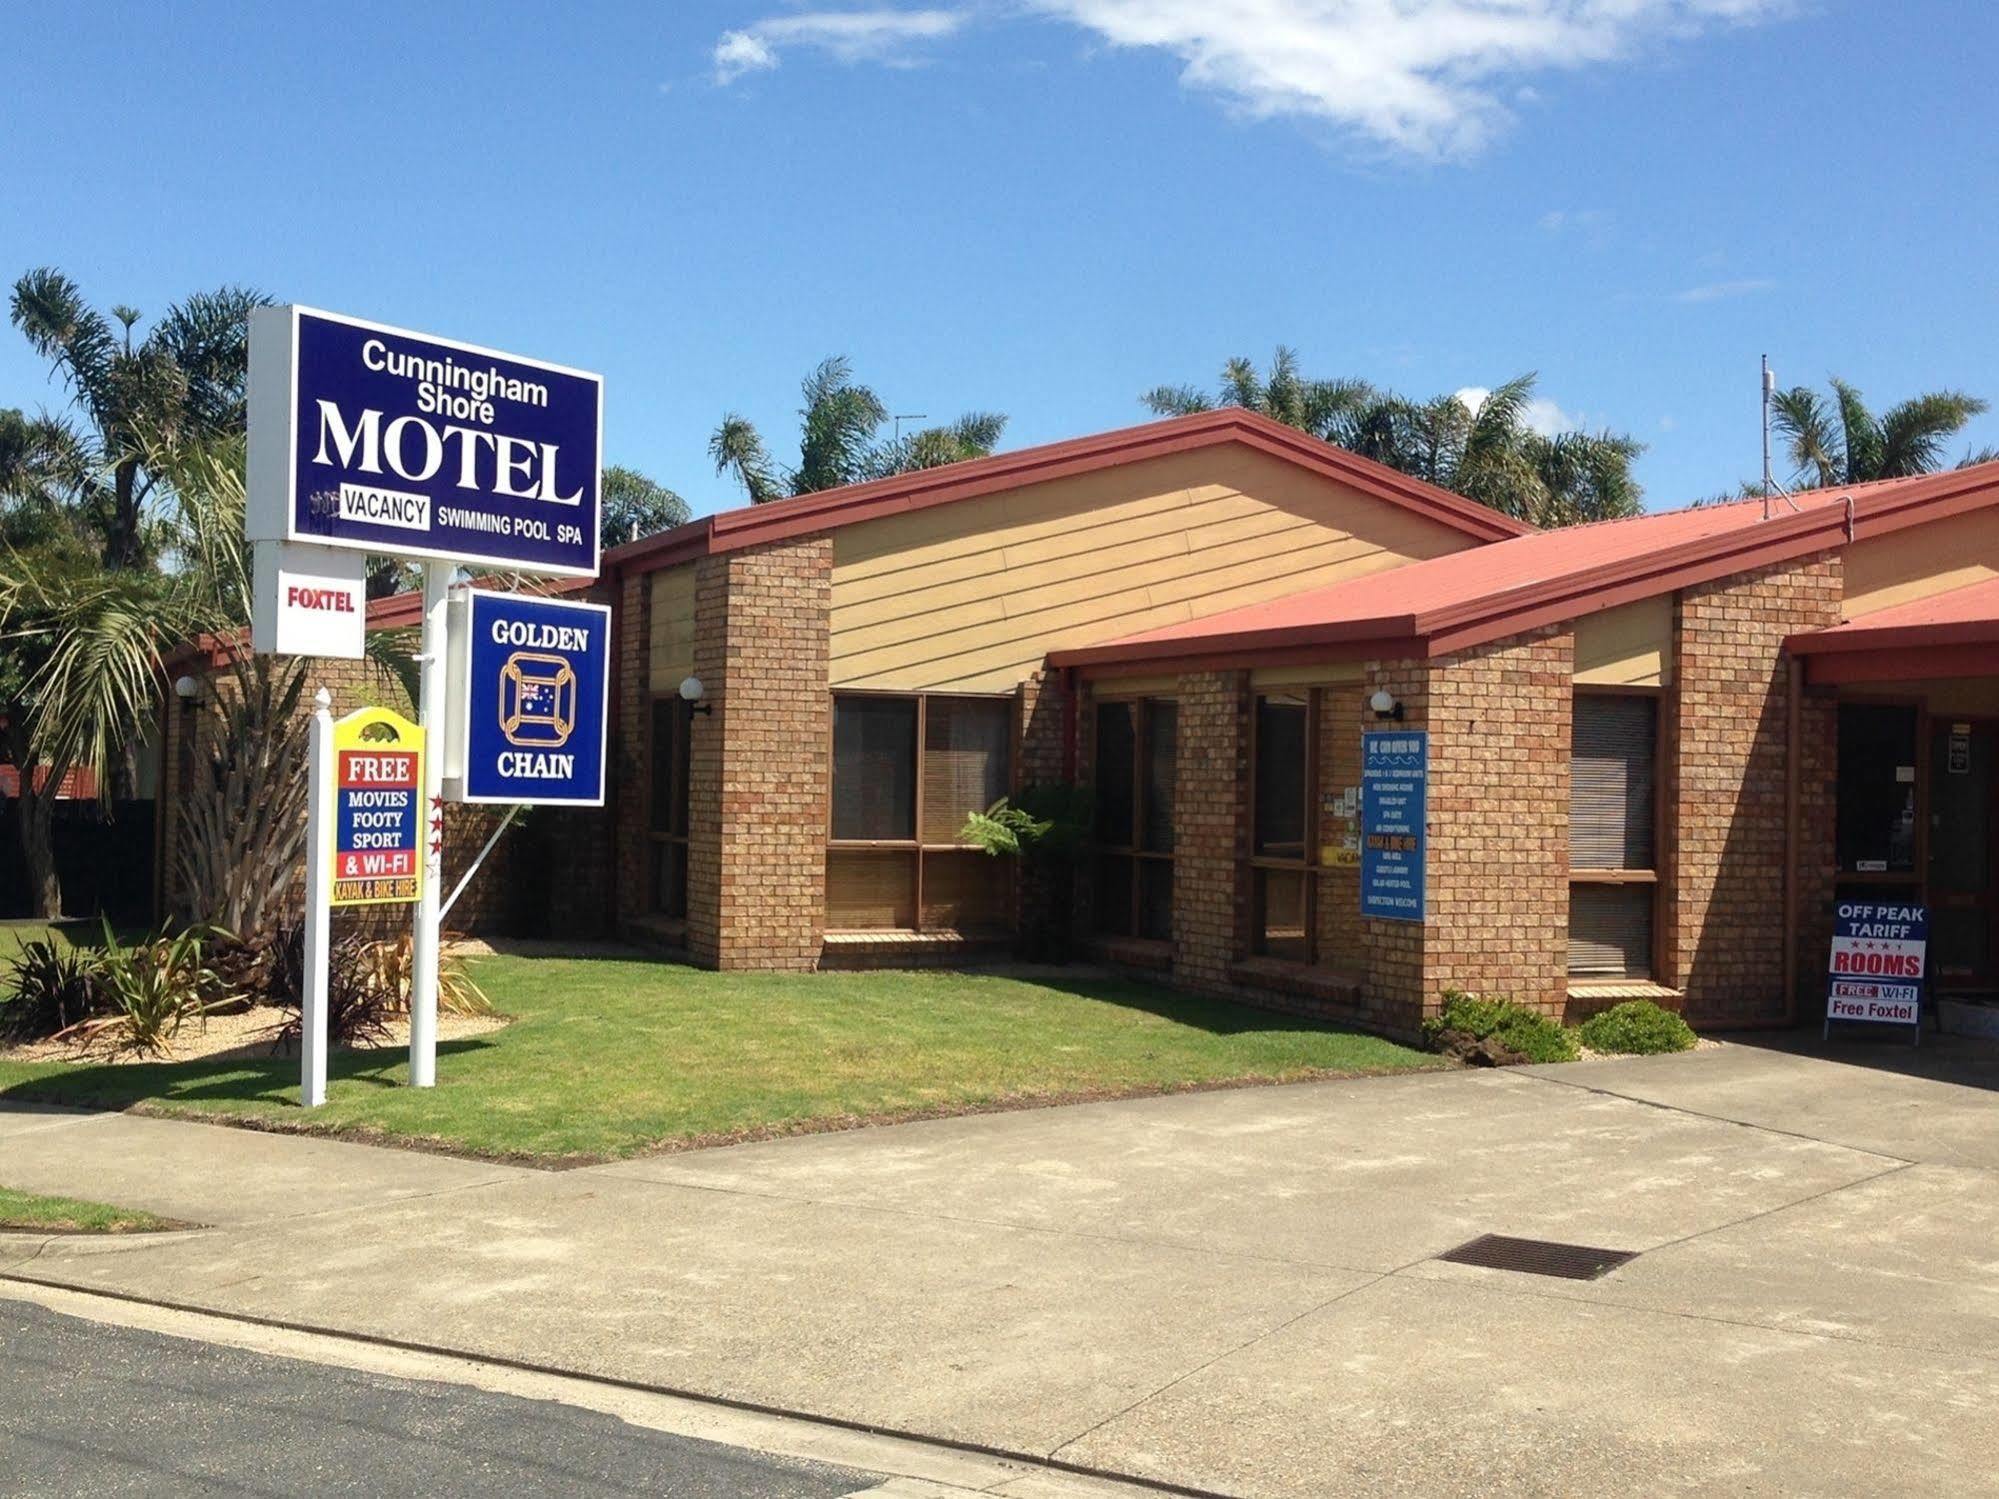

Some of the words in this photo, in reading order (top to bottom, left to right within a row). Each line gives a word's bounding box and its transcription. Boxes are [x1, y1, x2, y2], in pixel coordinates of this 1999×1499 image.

[363, 339, 548, 407] Cunningham
[417, 381, 495, 425] Shore
[312, 398, 584, 506] MOTEL
[344, 489, 427, 525] VACANCY
[438, 505, 511, 535] SWIMMING
[514, 519, 551, 542] POOL
[557, 523, 583, 546] SPA
[287, 586, 355, 613] FOXTEL
[491, 619, 589, 652] GOLDEN
[348, 757, 410, 783] FREE
[497, 751, 575, 779] CHAIN
[348, 791, 409, 808] MOVIES
[352, 811, 404, 828] FOOTY
[352, 832, 402, 849] SPORT
[345, 855, 359, 875] &
[363, 853, 409, 875] WI-FI
[335, 881, 364, 900] KAYAK
[365, 882, 373, 899] &
[374, 880, 394, 898] BIKE
[395, 879, 416, 897] HIRE
[1838, 904, 1873, 920] OFF
[1877, 906, 1924, 922] PEAK
[1849, 922, 1911, 939] TARIFF
[1834, 951, 1921, 977] ROOMS
[1839, 983, 1874, 997] FREE
[1881, 986, 1915, 1000] WI-FI
[1833, 1000, 1864, 1016] Free
[1868, 1002, 1912, 1020] Foxtel
